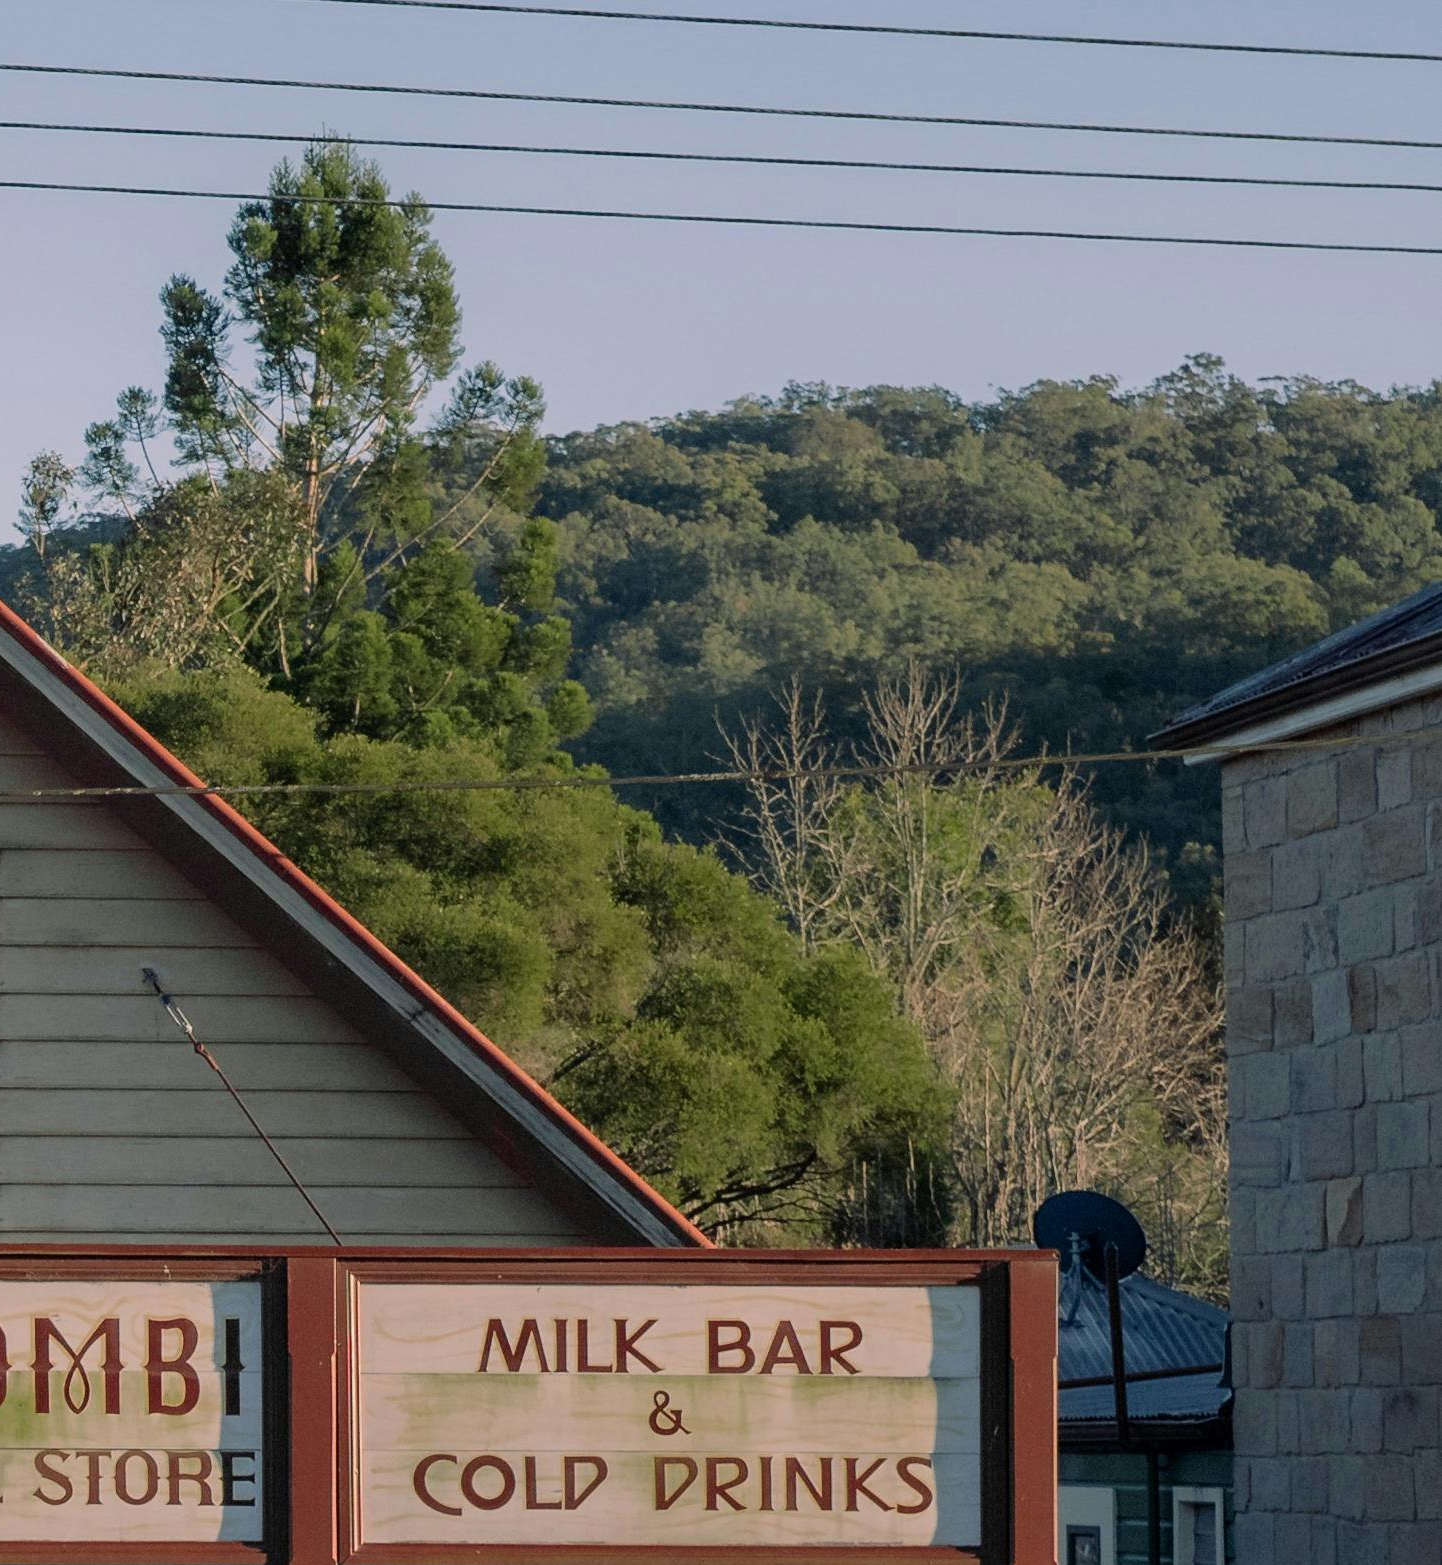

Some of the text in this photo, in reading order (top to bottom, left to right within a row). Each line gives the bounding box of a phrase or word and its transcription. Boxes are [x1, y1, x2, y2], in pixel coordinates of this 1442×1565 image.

[477, 1317, 864, 1376] MILK BAR
[648, 1389, 692, 1436] &
[32, 1448, 257, 1508] STORE
[412, 1453, 934, 1517] COLD DRINKS
